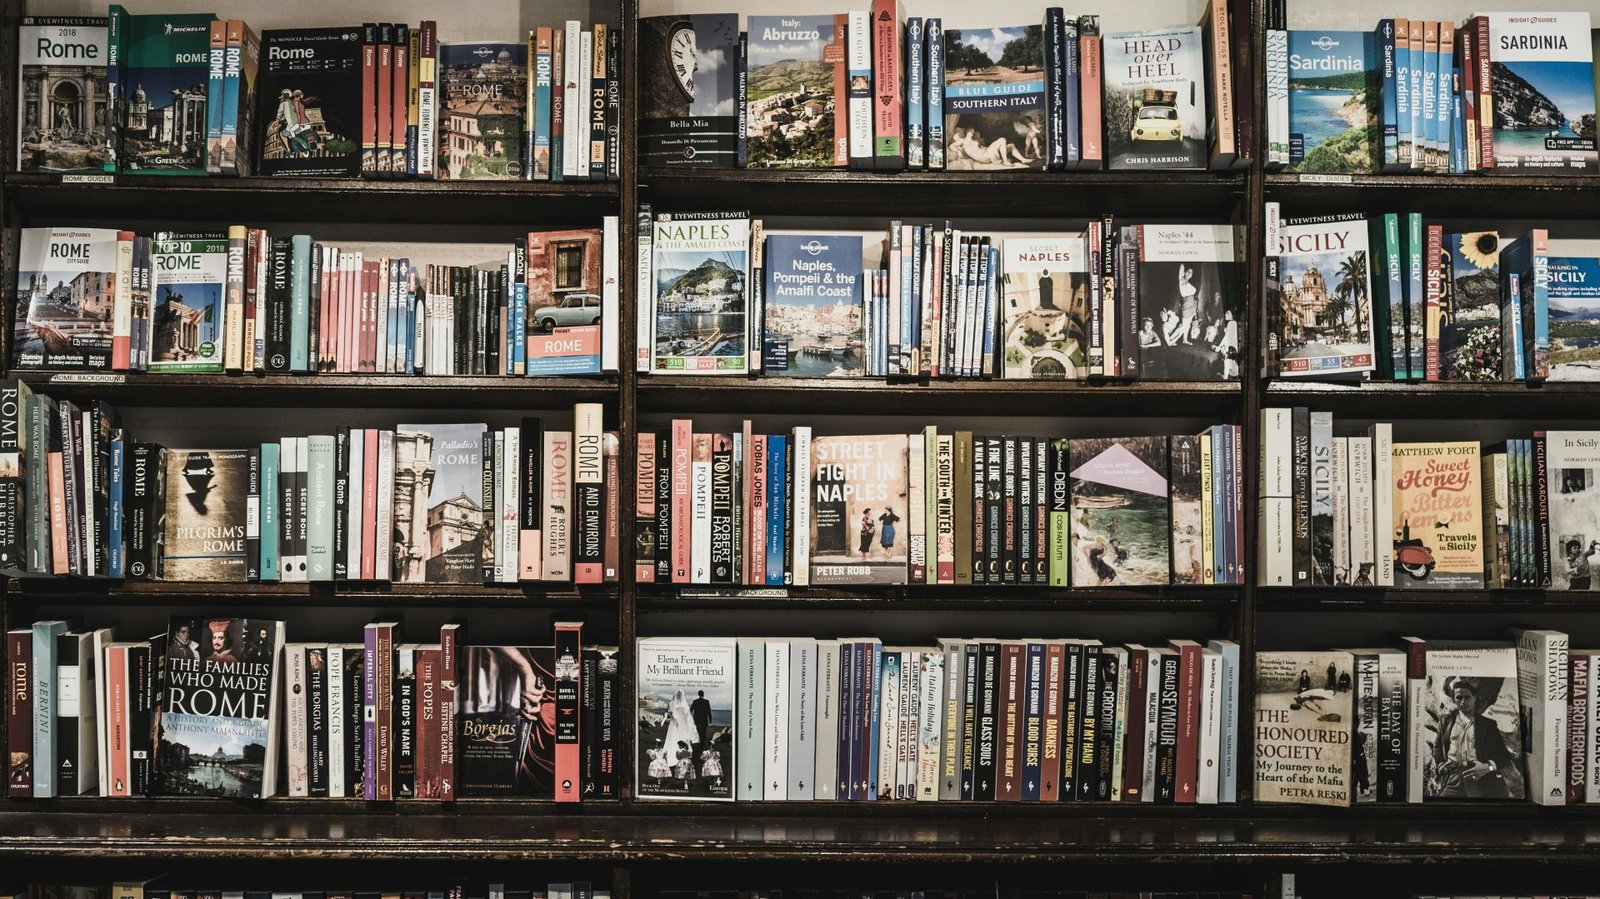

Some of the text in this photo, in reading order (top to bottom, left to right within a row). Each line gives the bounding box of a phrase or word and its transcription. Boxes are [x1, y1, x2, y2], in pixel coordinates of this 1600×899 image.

[58, 28, 76, 37] 2018
[763, 27, 819, 41] Abruzzo
[1124, 38, 1181, 54] HEAD
[1501, 35, 1568, 50] SARDINIA
[37, 38, 98, 58] Rome
[176, 54, 208, 63] ROME
[269, 47, 314, 60] Rome
[1134, 52, 1173, 63] over
[1384, 45, 1392, 78] Sardinia
[536, 56, 549, 87] ROME
[911, 43, 920, 105] Southern Italy
[930, 44, 940, 106] Southern Italy
[1128, 63, 1180, 79] HEEL
[1290, 54, 1363, 71] Sardinia
[953, 96, 1037, 109] SOUTHERN ITALY
[958, 84, 1032, 96] BLUE GUIDE
[1398, 67, 1407, 113] Sardinia
[1411, 70, 1421, 117] Sardinia
[1425, 72, 1435, 119] Sardinia
[1438, 74, 1450, 122] Sardinia
[593, 88, 604, 131] ROME
[692, 120, 709, 128] Mia
[658, 224, 730, 240] NAPLES
[51, 243, 90, 258] ROME
[157, 256, 201, 270] ROME
[1019, 253, 1070, 262] NAPLES
[1105, 239, 1113, 273] TRAVELER
[229, 247, 244, 283] ROME
[275, 252, 286, 290] ROME
[773, 272, 856, 285] Pompeii & the
[792, 260, 836, 272] Naples,
[1390, 254, 1399, 282] SICILY
[1412, 253, 1420, 281] SICILY
[1536, 257, 1548, 289] SICILY
[776, 286, 852, 297] Amalfi Coast
[1428, 270, 1439, 305] SICILY
[545, 340, 582, 352] ROME
[2, 388, 18, 448] ROME
[441, 441, 478, 449] Palladio's
[578, 435, 599, 479] ROME
[816, 441, 886, 460] STREET
[989, 447, 1000, 464] FINE
[1448, 447, 1476, 455] FORT
[1565, 439, 1599, 449] In Sicily
[438, 455, 478, 465] ROME
[551, 440, 567, 500] ROME
[676, 448, 687, 496] POMPEII
[754, 438, 763, 508] TOBIAS JONES
[817, 463, 896, 481] FIGHT IN
[989, 465, 1000, 482] LINE
[1425, 458, 1470, 474] Sweet
[134, 458, 145, 496] ROME
[638, 452, 654, 505] POMPEII
[714, 454, 730, 510] POMPEII
[1314, 446, 1330, 507] SICILY
[1397, 469, 1472, 498] Honey,
[1537, 440, 1547, 520] SICILIAN CAROUSEL
[337, 479, 345, 505] Rome
[696, 466, 706, 520] POMPEII
[817, 484, 888, 502] NAPLES
[1054, 472, 1066, 510] DIBDIN
[1410, 493, 1472, 513] Bitter
[586, 487, 599, 557] AND ENVIRONS
[659, 468, 669, 550] FROM POMPEII
[177, 526, 244, 539] PILGRIM'S
[203, 540, 244, 552] ROME
[550, 517, 558, 557] HUGHES
[713, 515, 722, 563] HARRIS
[722, 516, 730, 563] ROBERT
[1437, 534, 1477, 542] Travels
[1447, 542, 1477, 552] Sicily
[817, 566, 871, 575] PETER ROBB
[170, 658, 269, 677] THE FAMILIES
[646, 665, 724, 676] My Brilliant Friend
[657, 655, 713, 665] Elena Ferrante
[1549, 640, 1557, 701] SHADOWS
[1558, 640, 1568, 700] SICILIAN
[17, 662, 27, 701] rome
[170, 672, 267, 691] WHO MADE
[330, 652, 340, 734] POPE FRANCIS
[39, 680, 48, 734] BERNINI
[169, 687, 267, 720] ROME
[312, 670, 321, 730] THE BORGIAS
[424, 681, 433, 720] POPES
[1149, 692, 1157, 724] MALACQUA
[1160, 660, 1178, 746] GERALD SEYMOUR
[402, 684, 410, 756] IN GOD'S NAME
[1257, 709, 1289, 723] THE
[1381, 697, 1390, 740] BATTLE
[1392, 682, 1402, 755] THE DAY OF
[1571, 660, 1587, 786] MAFIA BROTHERHOODS
[980, 716, 992, 766] GLASS SOULS
[1027, 716, 1039, 767] BLOOD CURSE
[1046, 718, 1057, 759] DARKNESS
[1082, 718, 1095, 764] BY MY HAND
[1256, 727, 1349, 744] HONOURED
[1255, 745, 1323, 760] SOCIETY
[1256, 761, 1343, 774] My Journey to the
[1256, 773, 1343, 786] Heart of the Mafia
[1280, 788, 1346, 800] PETRA RESKI
